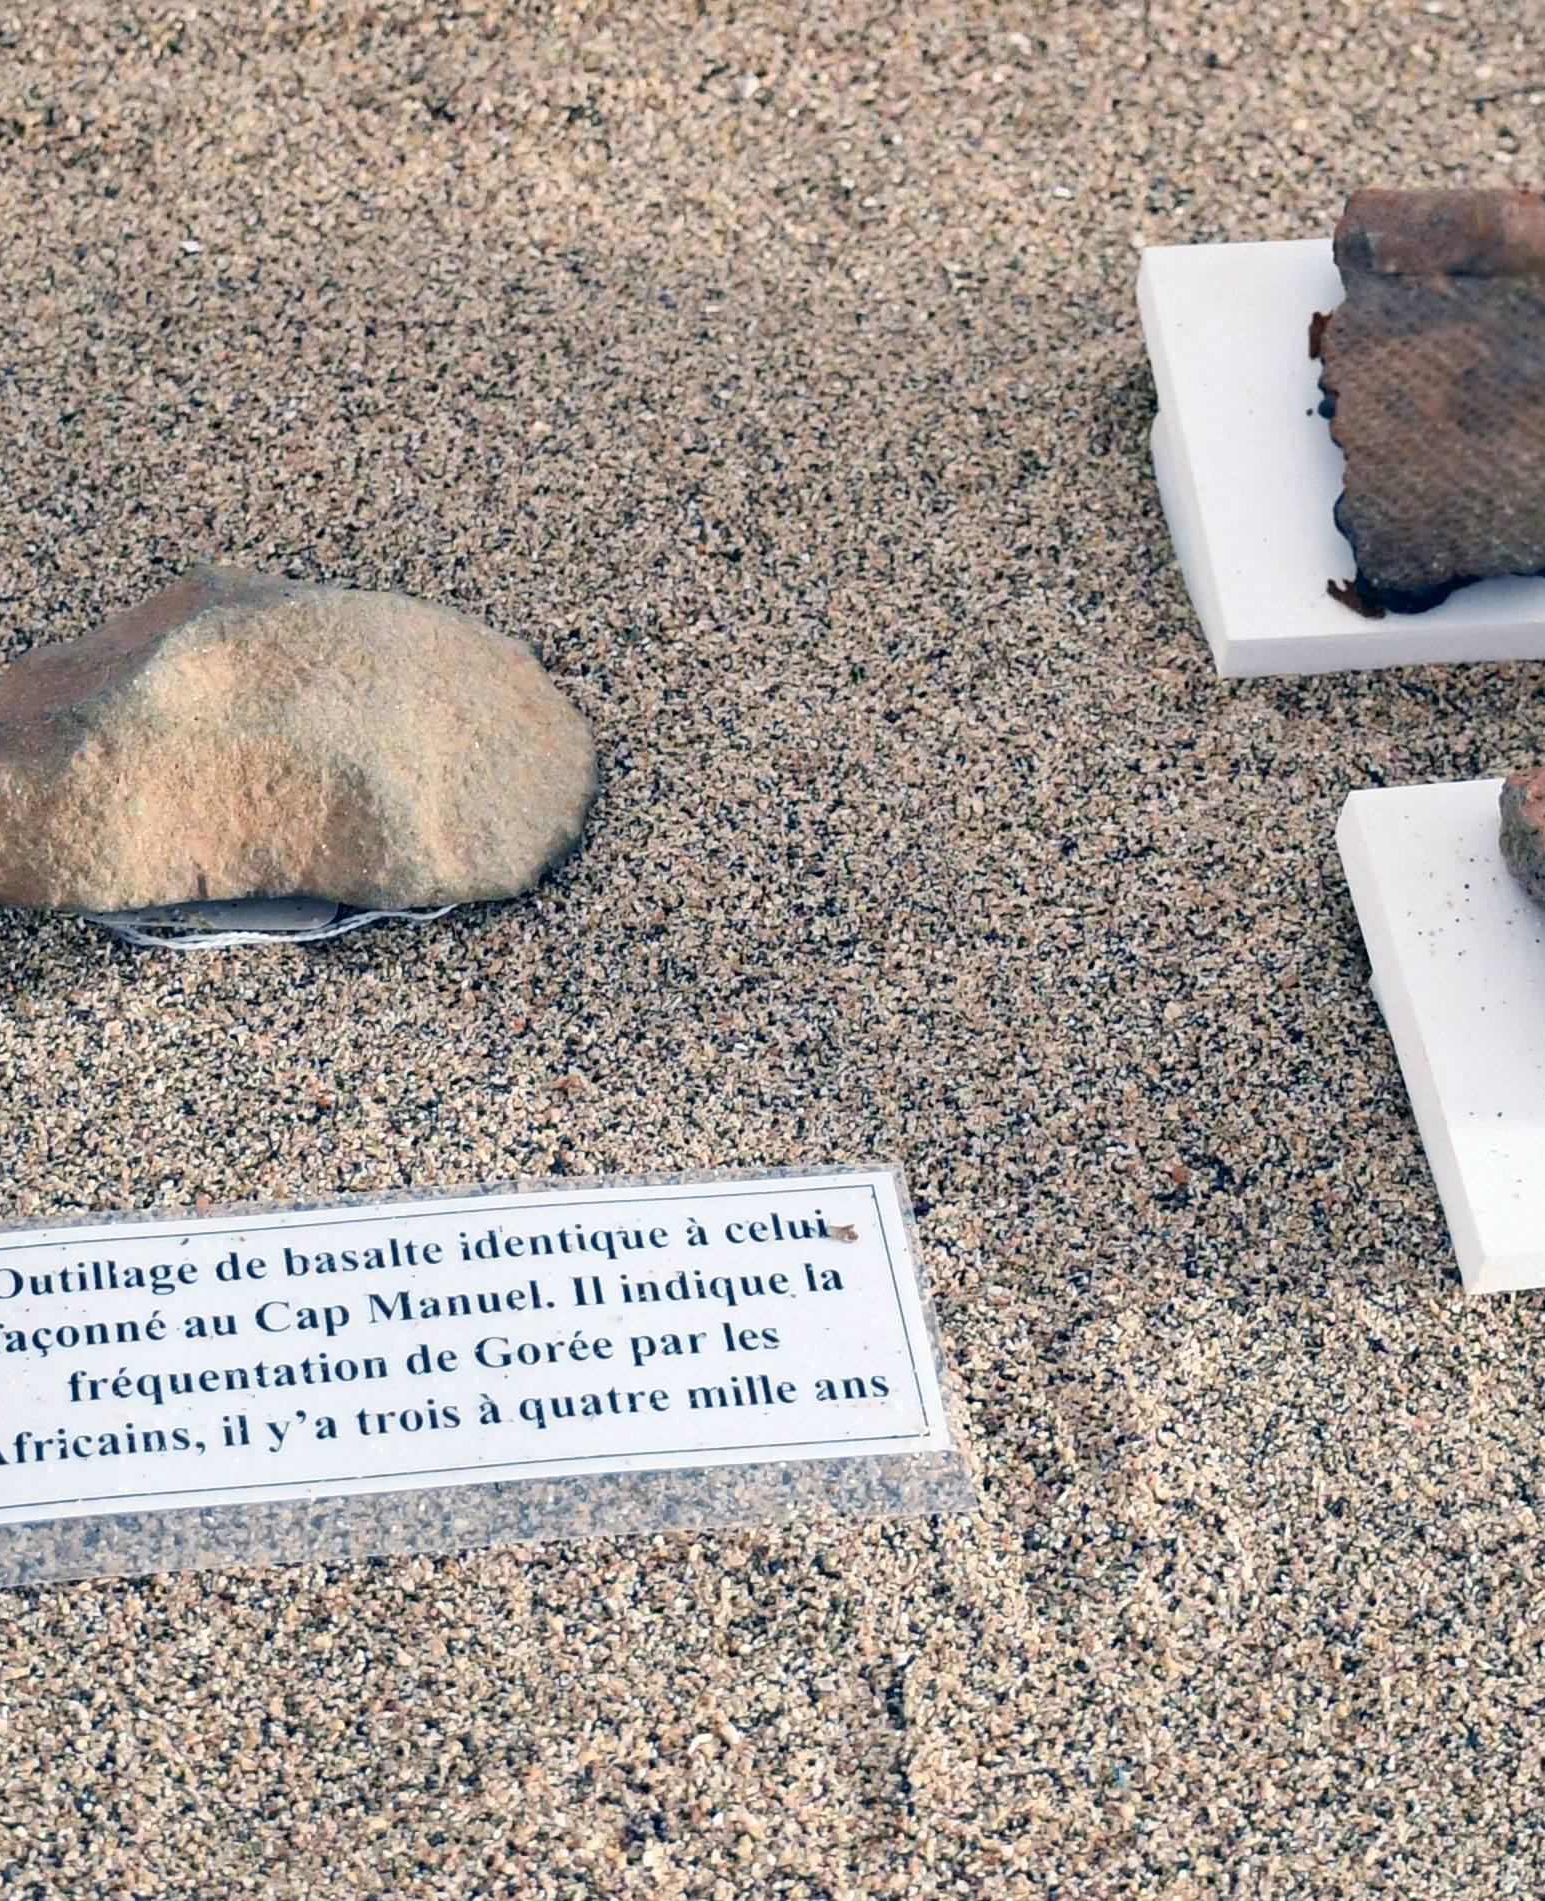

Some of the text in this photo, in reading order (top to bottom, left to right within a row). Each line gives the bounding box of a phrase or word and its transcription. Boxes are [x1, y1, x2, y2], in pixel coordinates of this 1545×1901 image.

[216, 1253, 266, 1281] de
[284, 1239, 441, 1276] basalte
[461, 1224, 668, 1261] identique
[686, 1218, 709, 1247] à
[725, 1209, 830, 1244] celui
[185, 1316, 237, 1338] au
[256, 1302, 349, 1336] Cap
[369, 1281, 554, 1323] Manuel.
[574, 1276, 604, 1305] Il
[622, 1270, 789, 1307] indique
[805, 1264, 843, 1291] la
[68, 1323, 779, 1405] fréquentation de Gorée par les
[223, 1415, 249, 1446] il
[357, 1399, 460, 1435] trois
[480, 1394, 502, 1425] à
[520, 1387, 669, 1430] quatre
[688, 1375, 796, 1408] mille
[815, 1376, 889, 1401] ans
